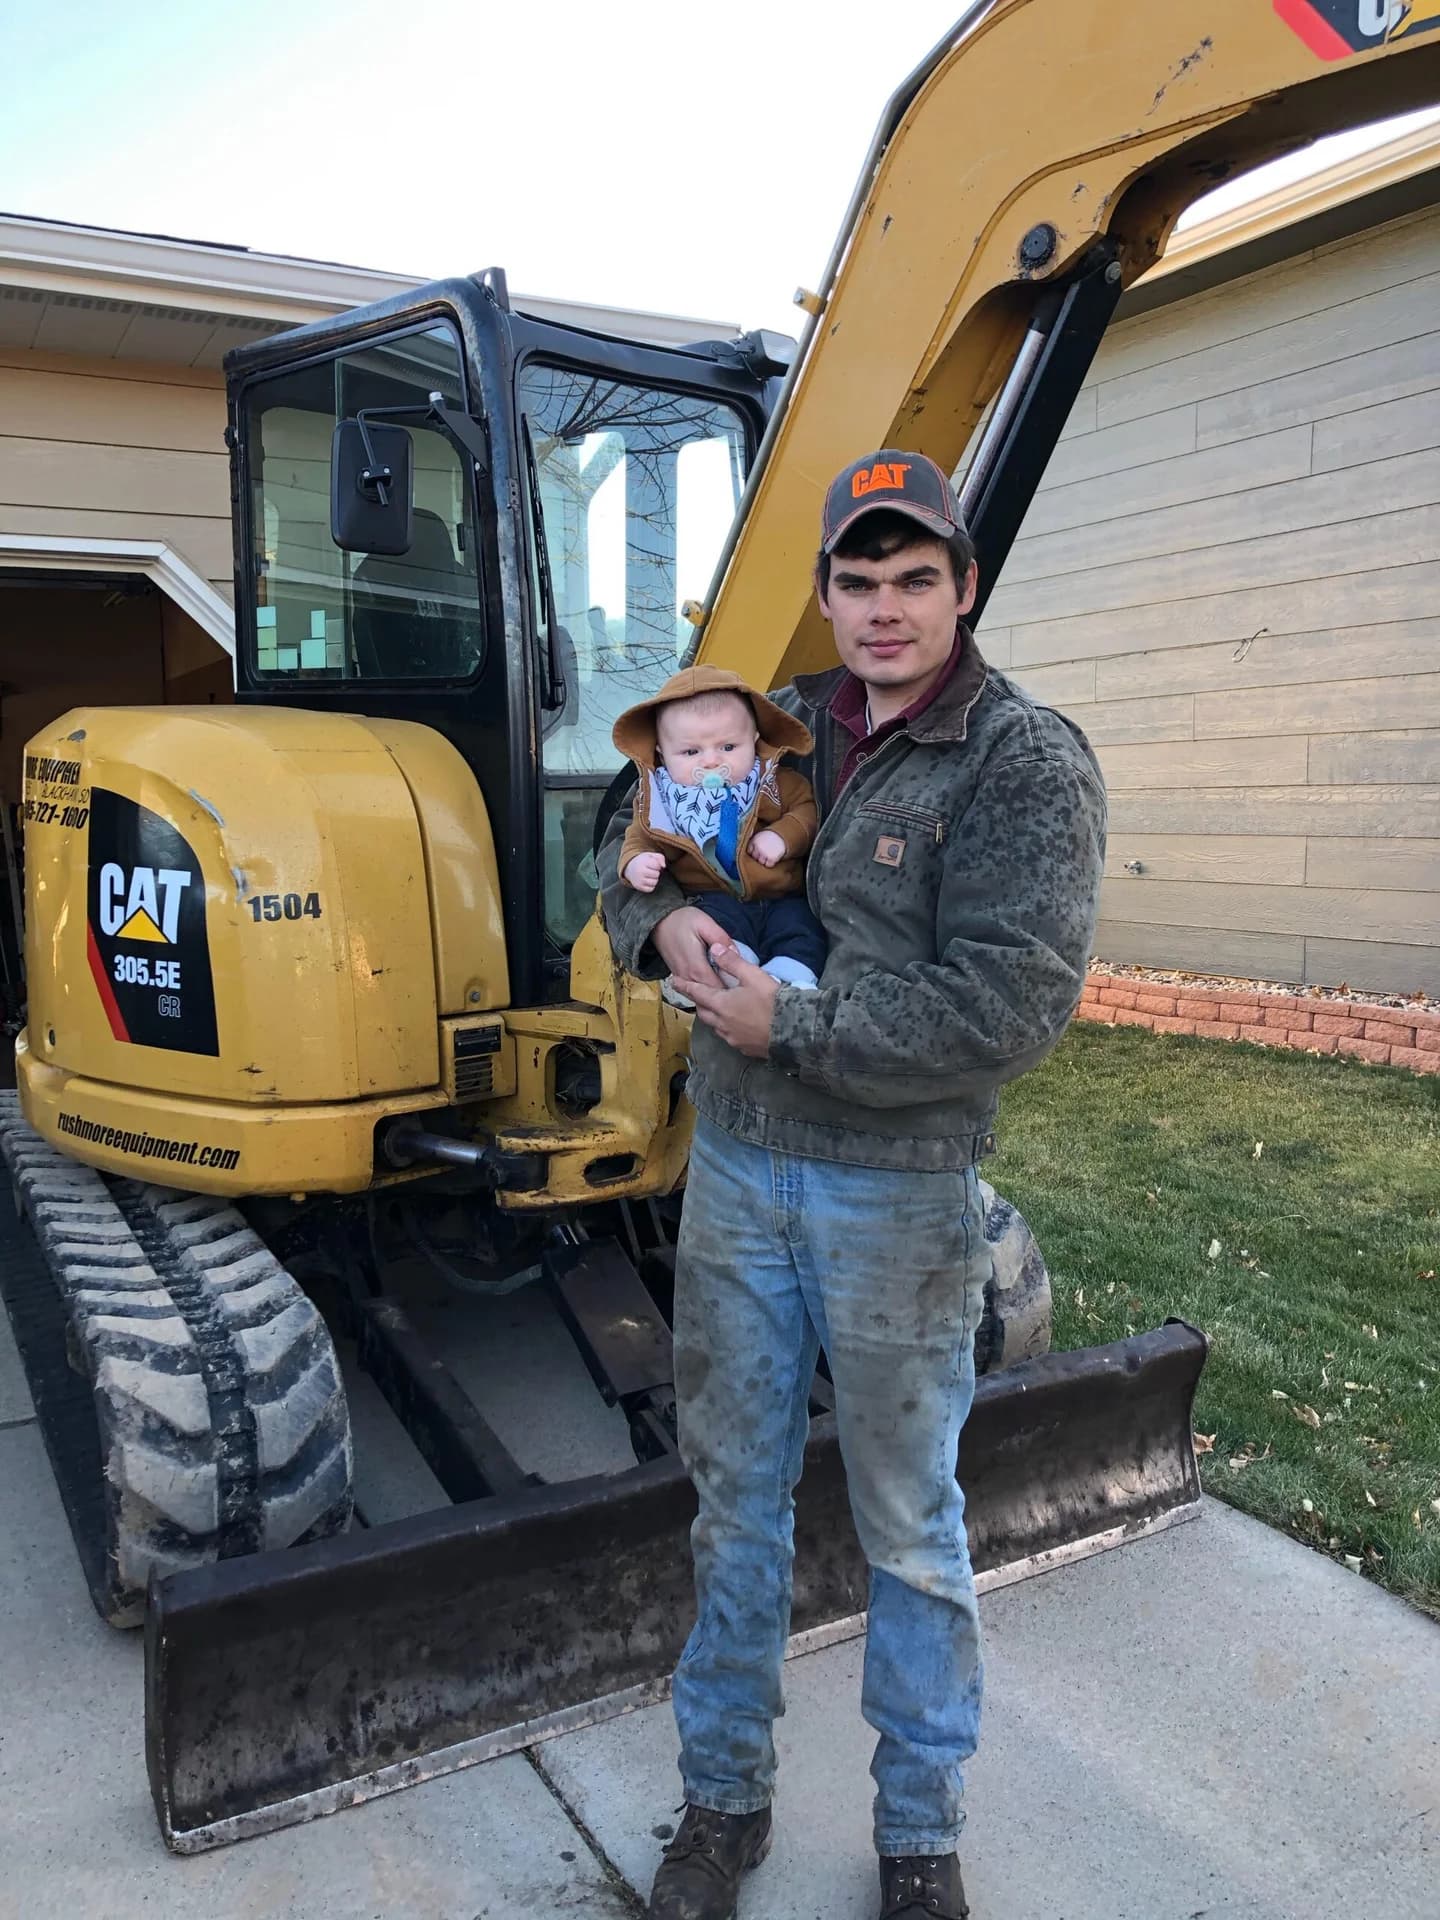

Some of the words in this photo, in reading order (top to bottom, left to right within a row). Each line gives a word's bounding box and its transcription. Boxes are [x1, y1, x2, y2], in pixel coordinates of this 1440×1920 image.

[852, 463, 908, 498] CAT
[99, 862, 191, 945] CAT
[247, 892, 322, 922] 1504
[114, 954, 181, 989] 305.5E
[157, 994, 181, 1018] CR
[57, 1111, 241, 1171] rushmoreequipment.com
